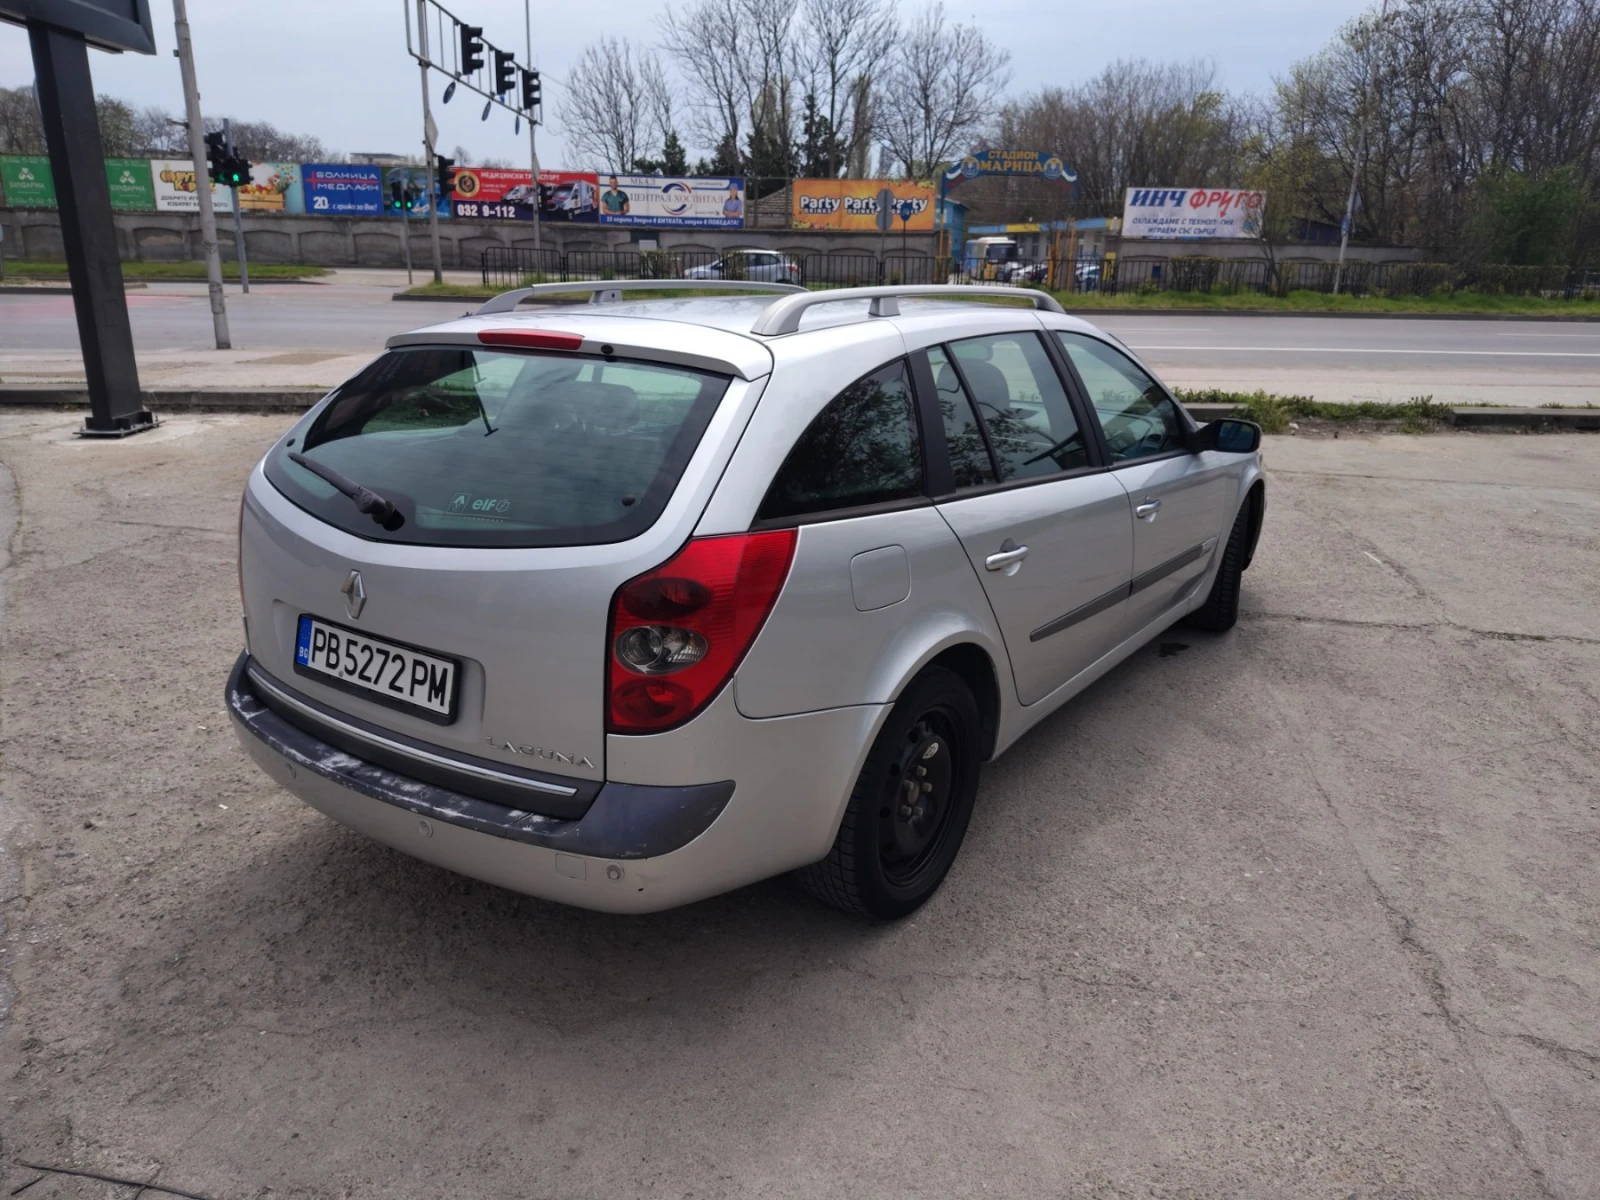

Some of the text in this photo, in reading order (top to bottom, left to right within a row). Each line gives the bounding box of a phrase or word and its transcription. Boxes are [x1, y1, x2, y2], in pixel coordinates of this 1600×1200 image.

[988, 150, 1039, 160] СТАДИОН
[980, 160, 1044, 173] МАРИЦА
[316, 171, 377, 180] БОЛНИЦА
[630, 178, 656, 186] МБАЛ
[317, 182, 379, 191] МЕДЛАЙН
[630, 193, 724, 203] ЦЕНТРАЛ ХОСПИТАЛ
[800, 196, 840, 211] Party
[844, 196, 881, 211] Party
[1129, 189, 1263, 212] ИНЧ ФРИГО
[457, 204, 478, 217] 032
[482, 205, 516, 218] 9-112
[1132, 217, 1179, 225] ОХЛАЖДАМЕ
[472, 498, 497, 511] elf
[298, 646, 309, 659] BG
[485, 735, 597, 769] LAGUNA
